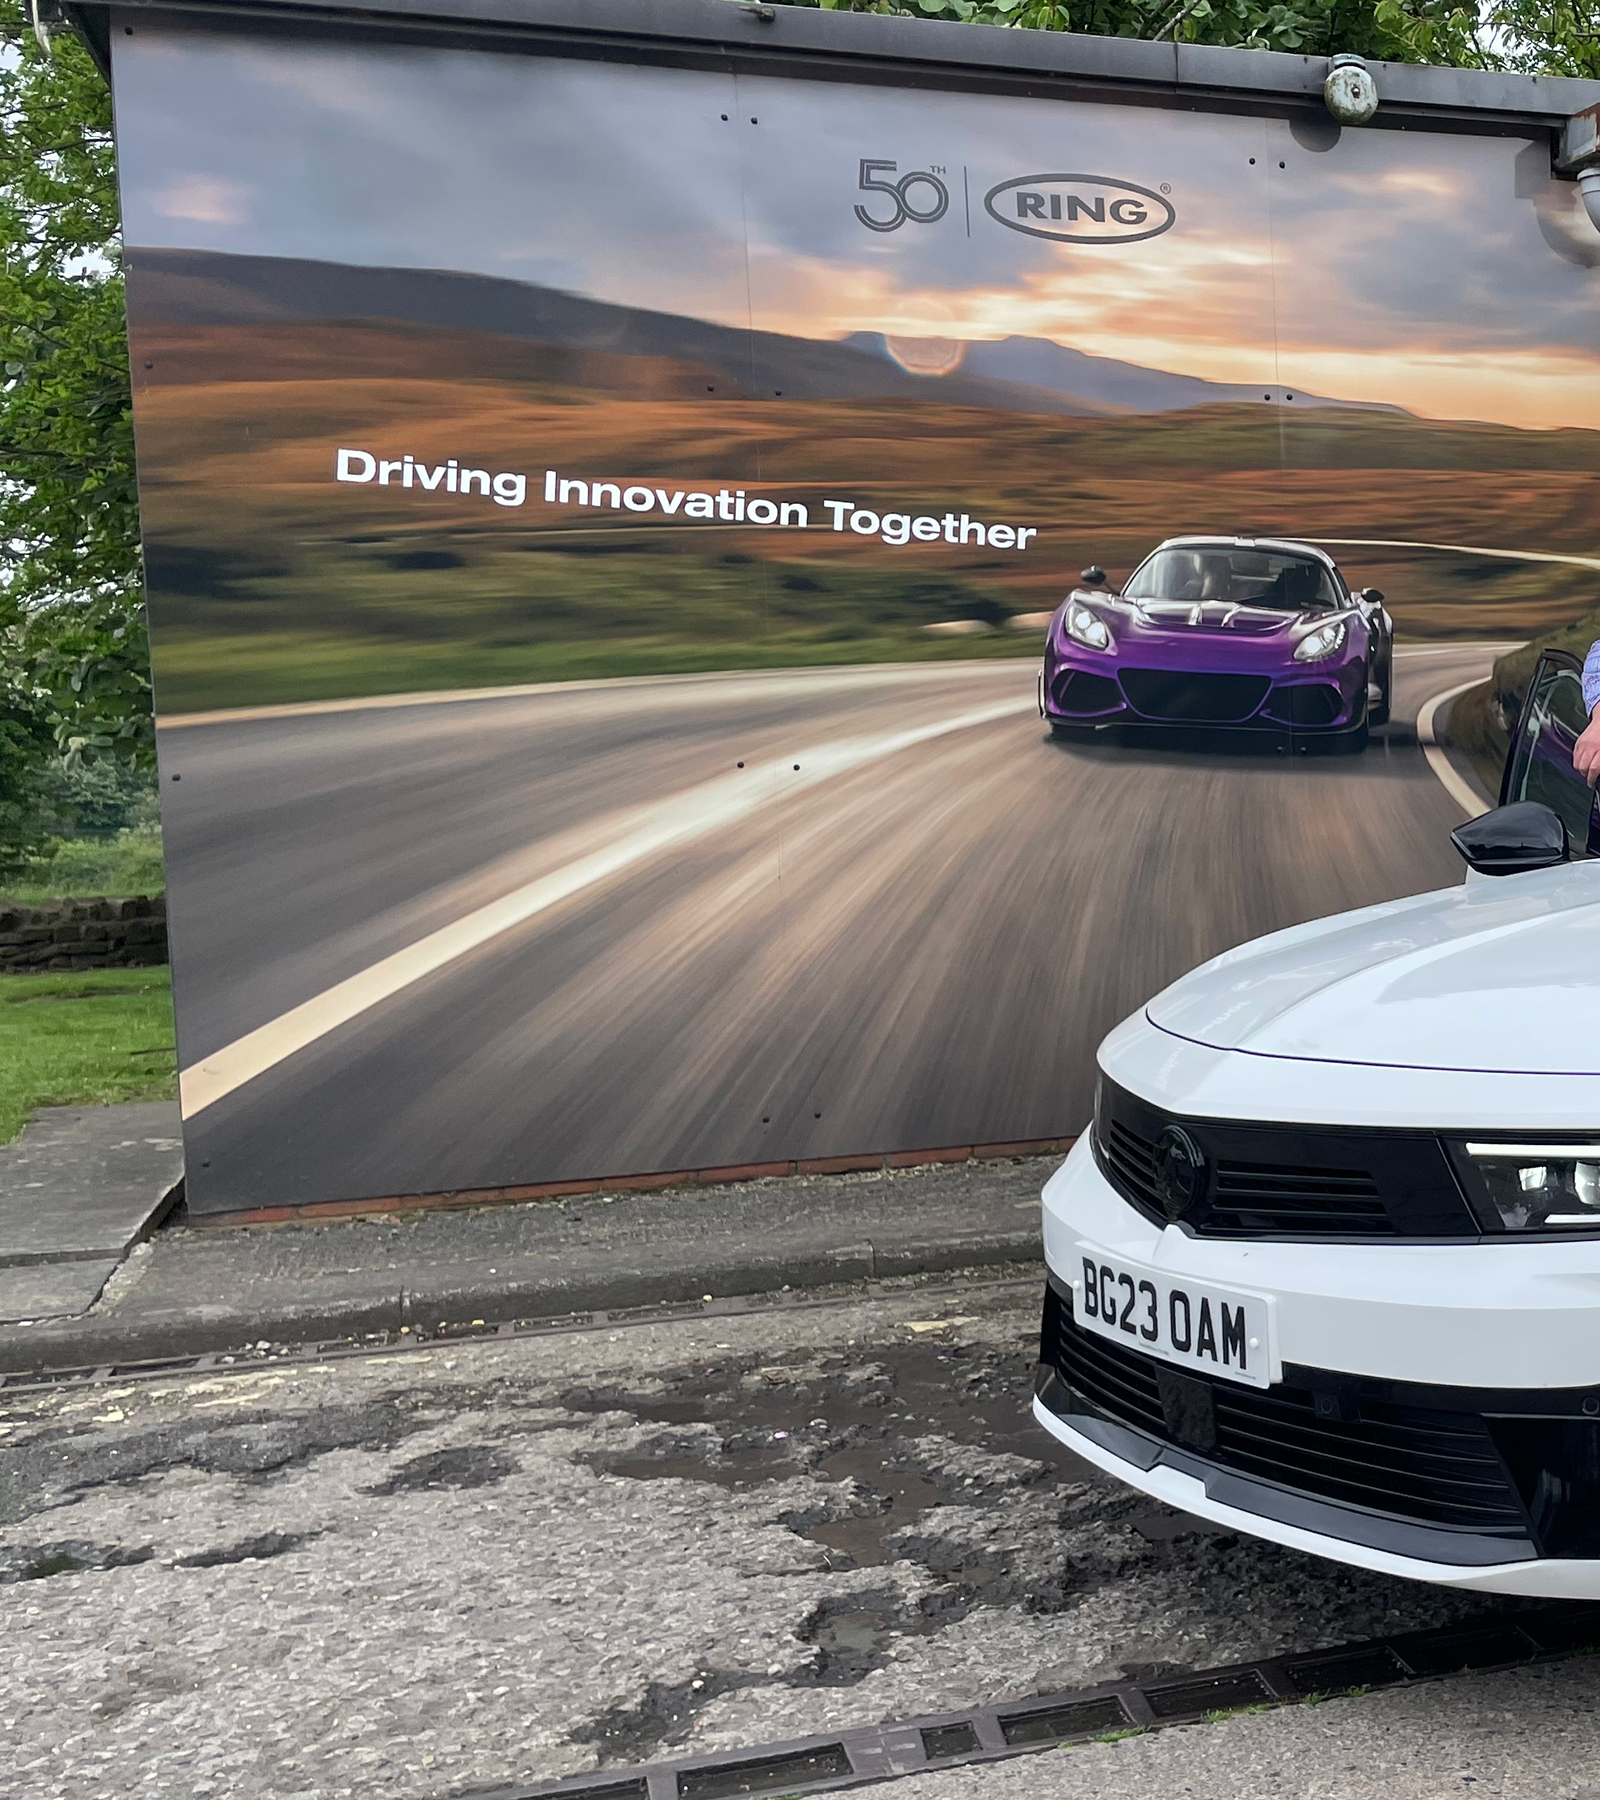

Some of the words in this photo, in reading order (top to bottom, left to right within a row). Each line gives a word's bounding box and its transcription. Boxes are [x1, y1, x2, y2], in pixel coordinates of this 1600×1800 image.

[1016, 191, 1148, 226] RING
[336, 448, 528, 507] Driving
[544, 470, 809, 528] Innovation
[824, 499, 1038, 550] Together
[1082, 1256, 1159, 1343] BG23
[1169, 1289, 1247, 1371] OAM
